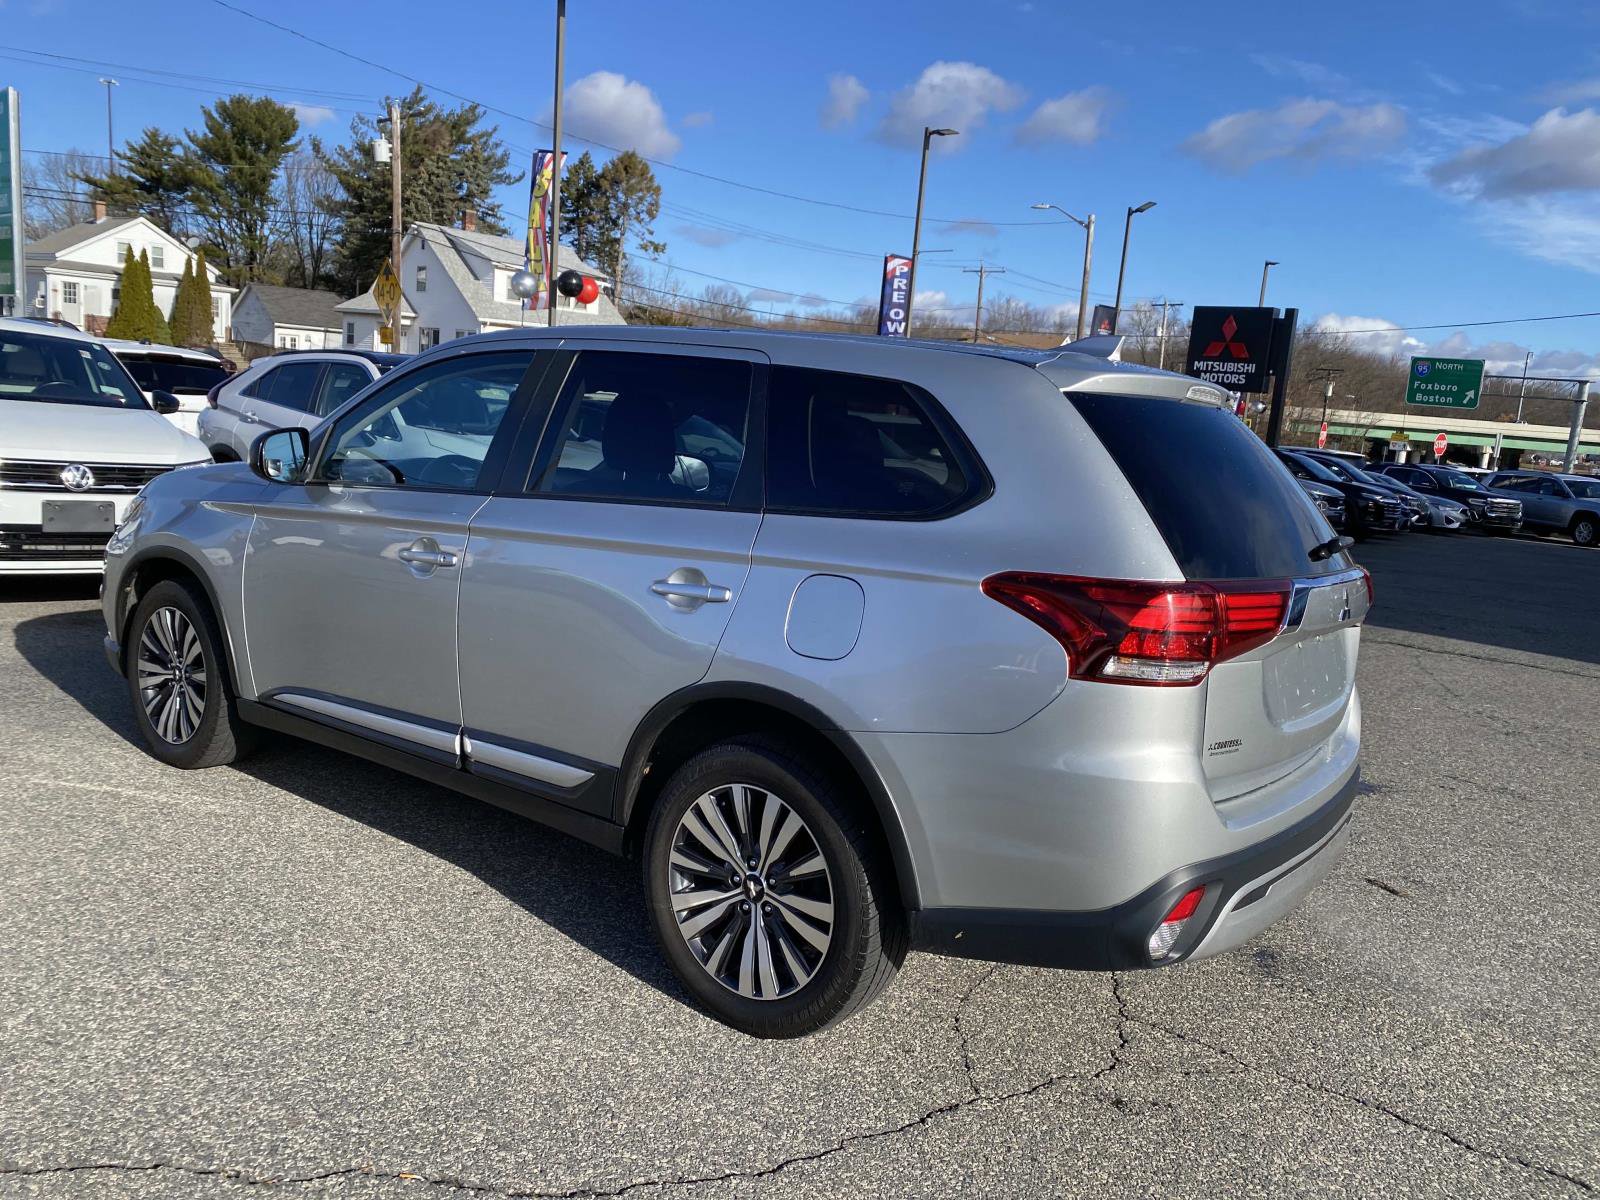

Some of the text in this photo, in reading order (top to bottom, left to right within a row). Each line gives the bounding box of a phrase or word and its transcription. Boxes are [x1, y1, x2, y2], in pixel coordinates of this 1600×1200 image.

[887, 308, 906, 337] OW
[1193, 360, 1256, 374] MITSUBISHI
[1417, 365, 1428, 374] 95
[1200, 372, 1246, 384] MOTORS
[1413, 381, 1458, 392] Foxboro
[1415, 393, 1453, 404] Boston
[1434, 440, 1448, 449] STOP
